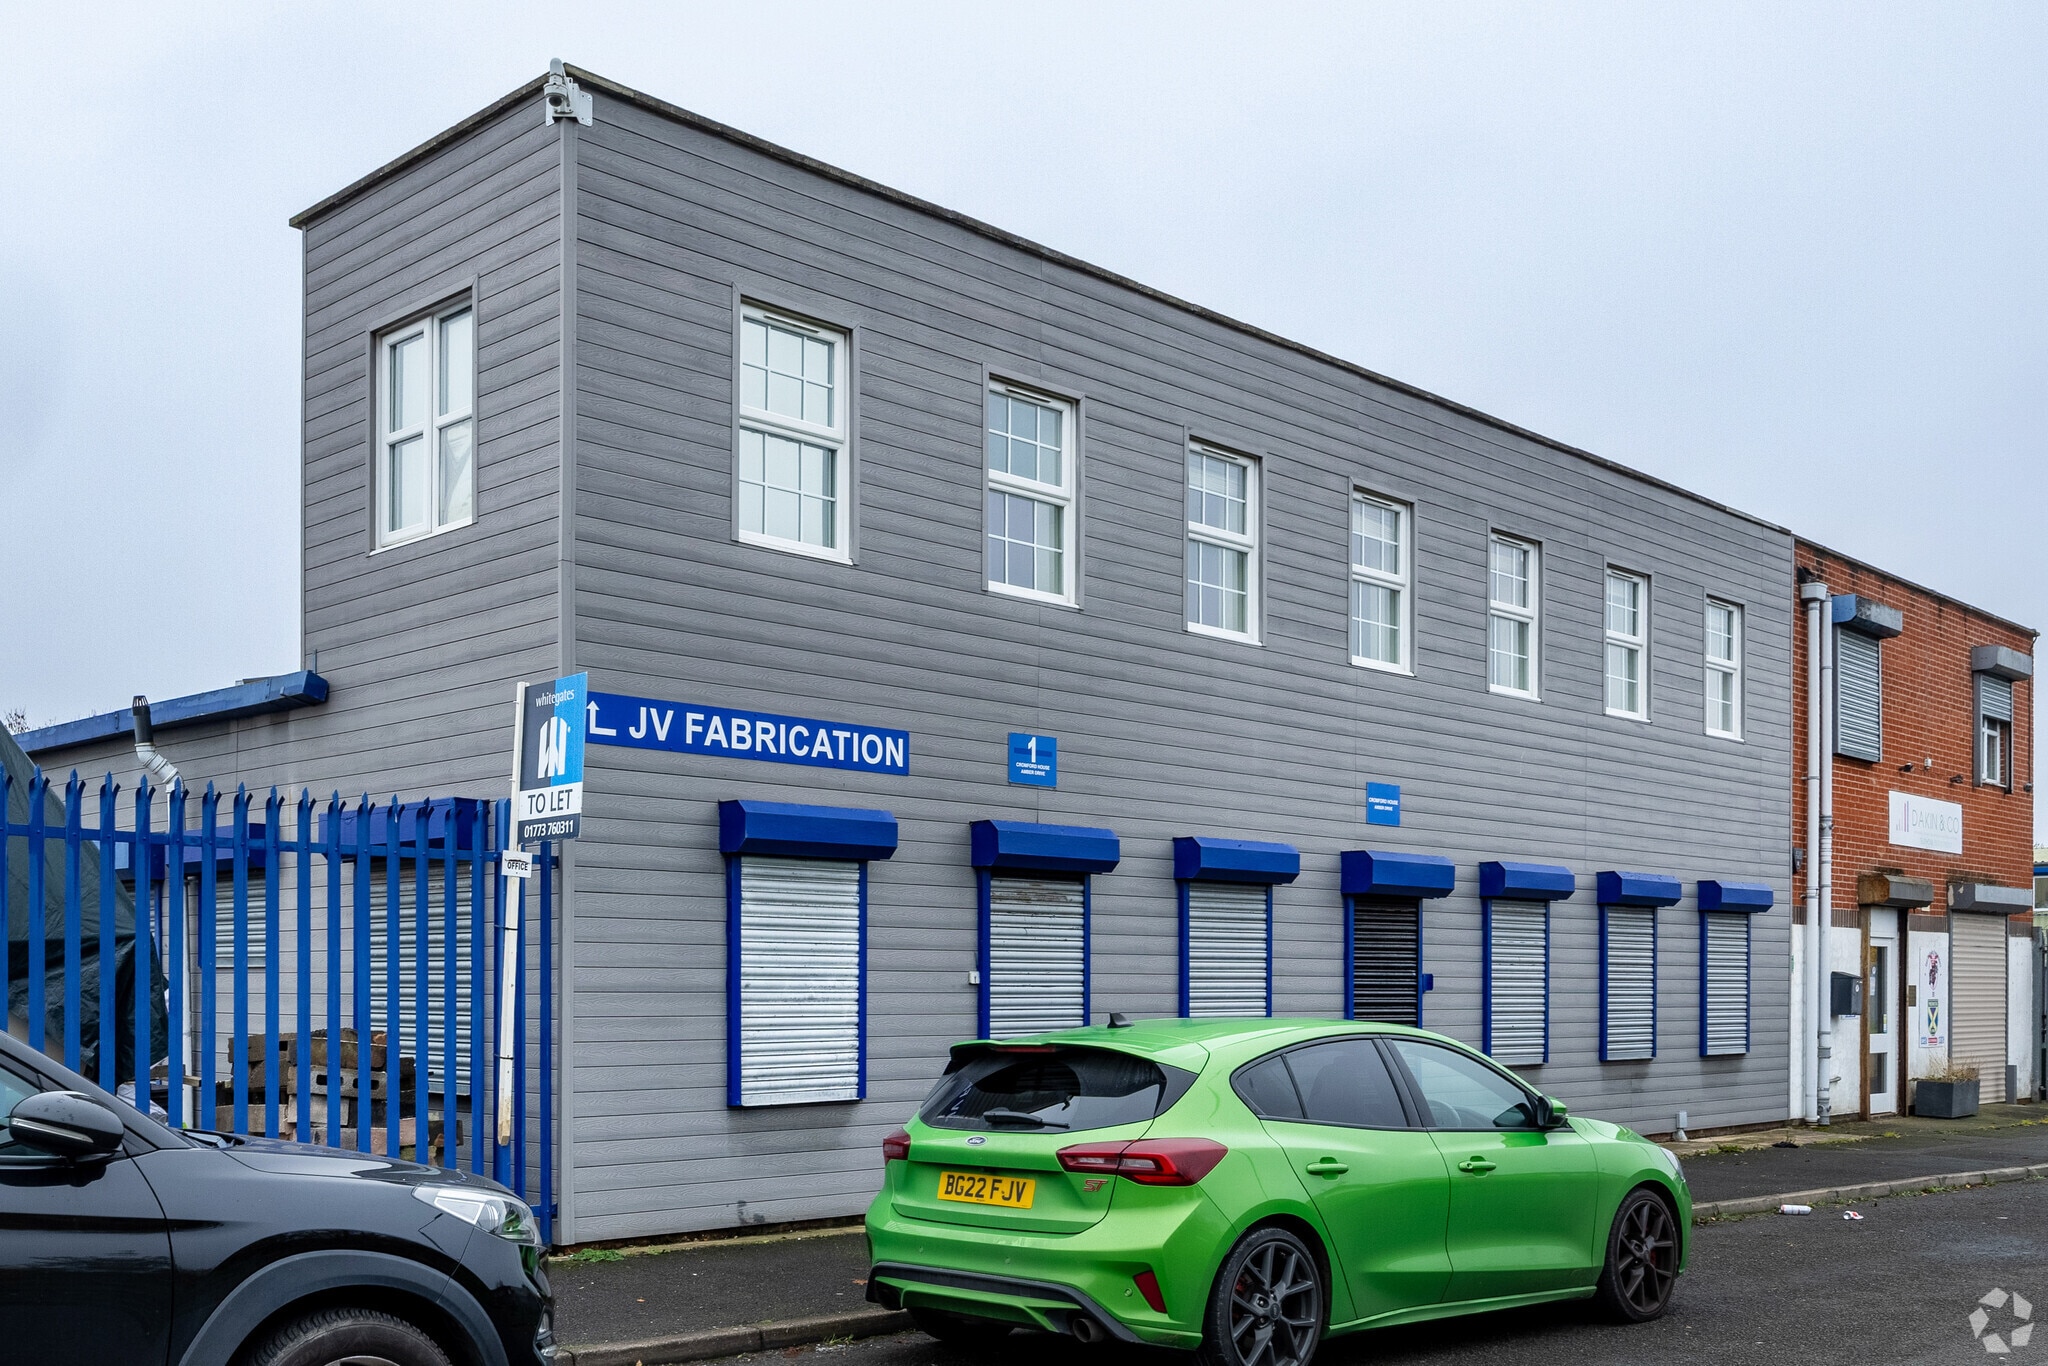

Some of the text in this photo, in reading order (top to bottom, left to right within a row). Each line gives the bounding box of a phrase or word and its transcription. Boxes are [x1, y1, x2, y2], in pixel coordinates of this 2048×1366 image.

[535, 689, 575, 707] whitegates
[628, 706, 904, 768] JV FABRICATION
[1027, 736, 1037, 763] 1
[528, 789, 573, 815] TO LET
[524, 820, 574, 838] 01773 760311
[1911, 809, 1938, 830] DAKIN
[507, 861, 528, 871] OFFICE
[944, 1174, 1027, 1203] BG22 FJV
[1083, 1179, 1108, 1192] ST
